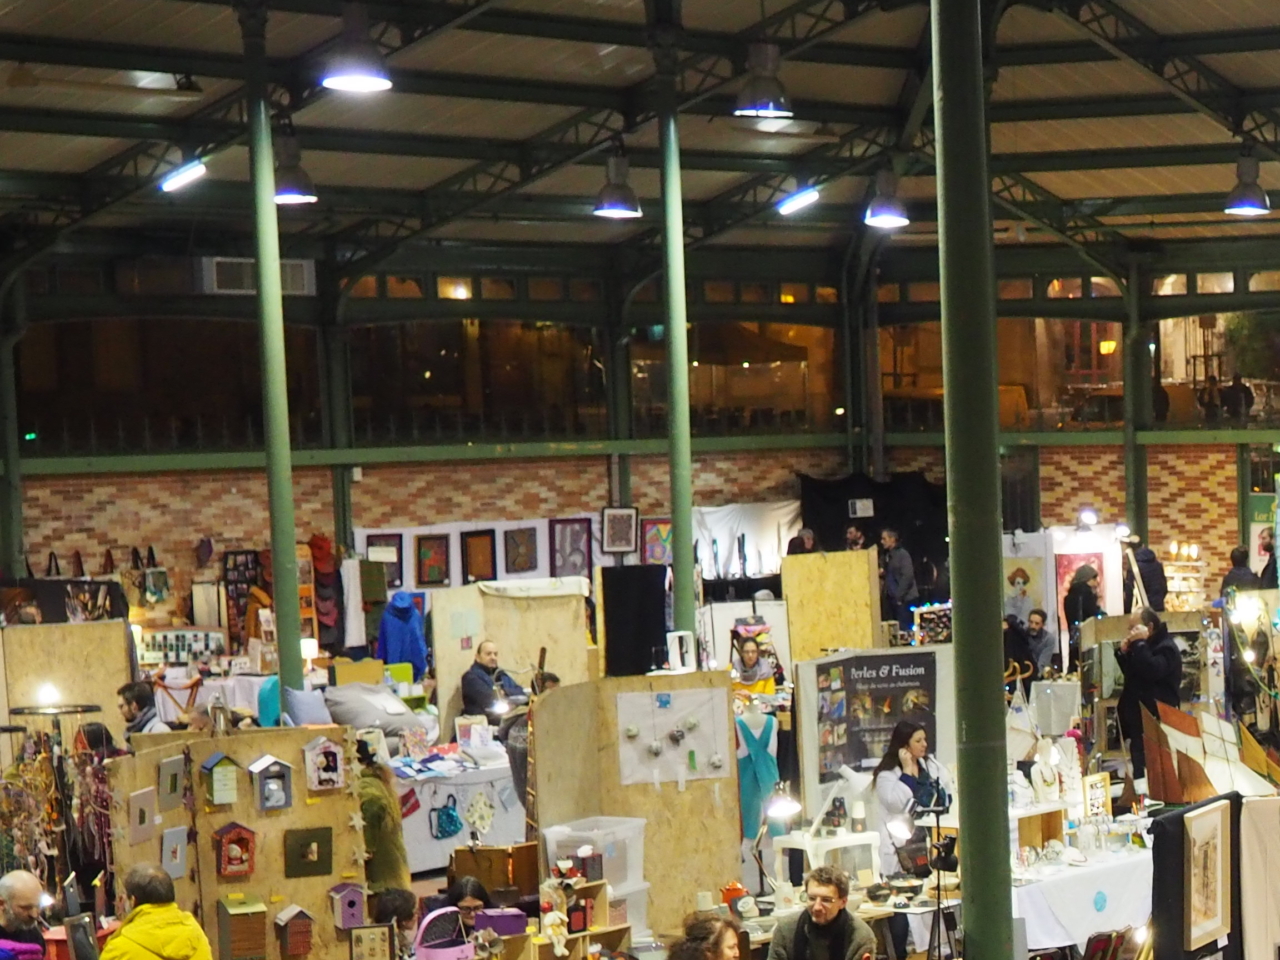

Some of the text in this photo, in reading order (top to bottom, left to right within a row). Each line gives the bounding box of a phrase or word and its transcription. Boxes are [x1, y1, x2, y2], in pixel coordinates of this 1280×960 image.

[850, 664, 925, 679] Perles & Fusion
